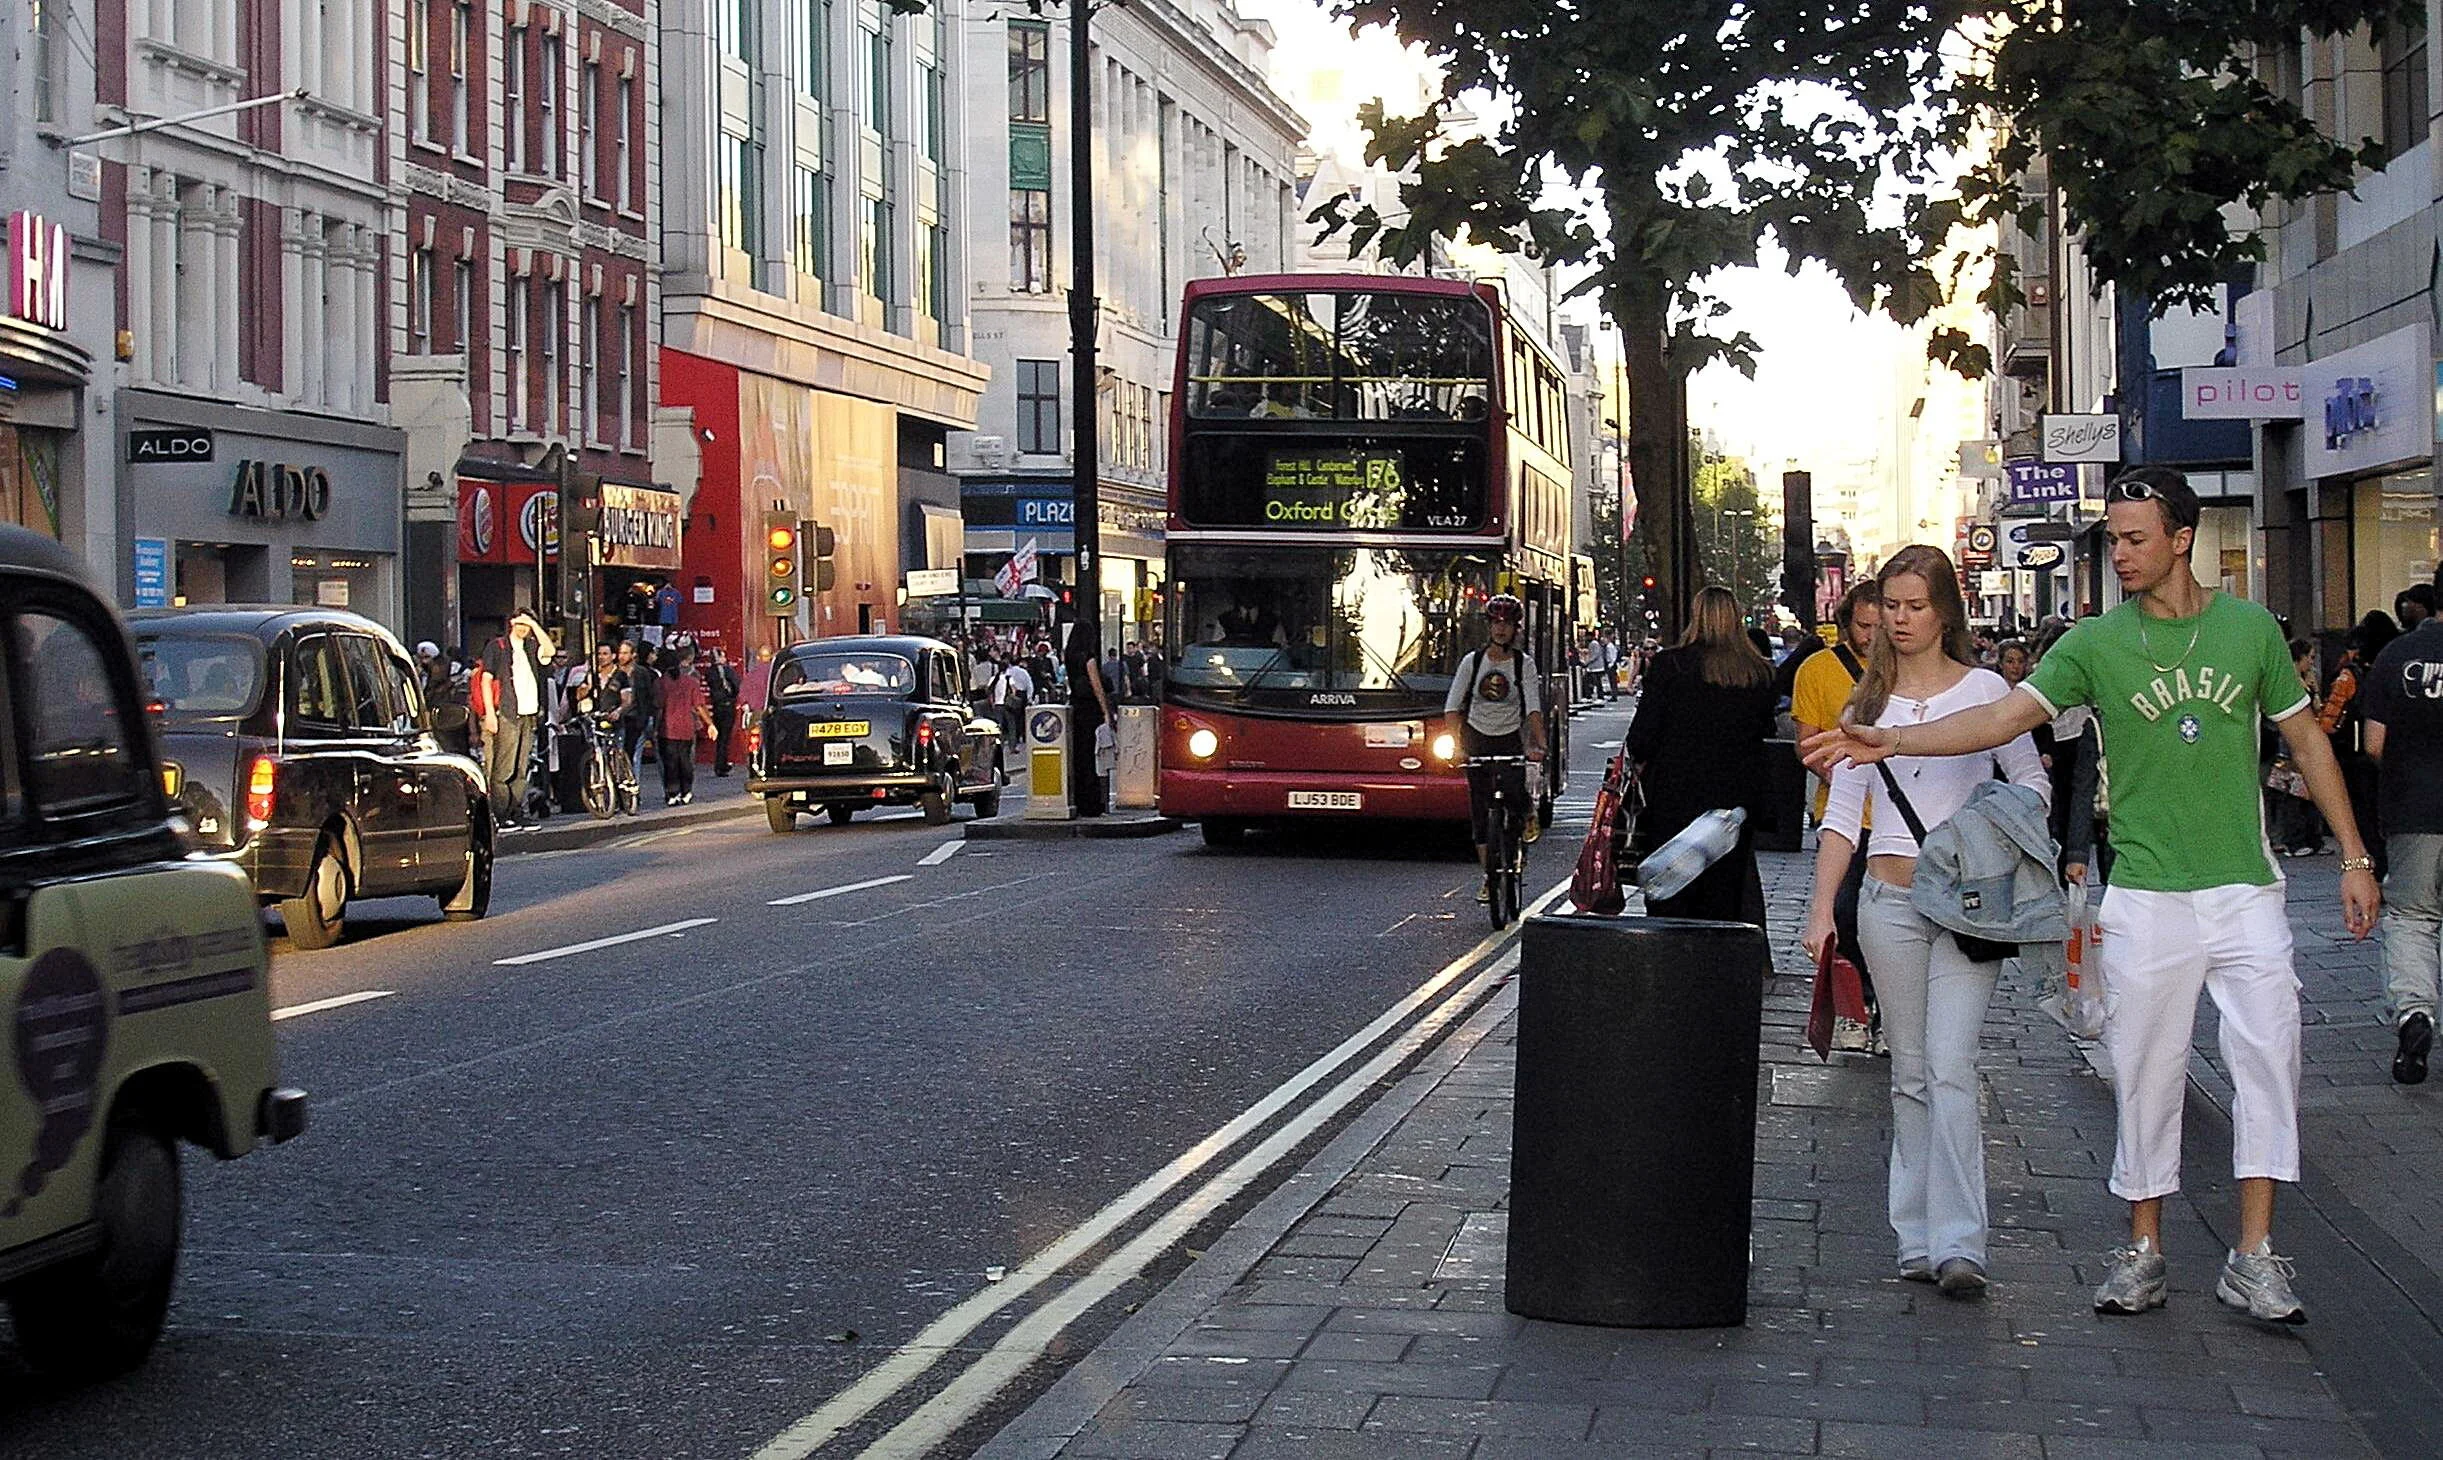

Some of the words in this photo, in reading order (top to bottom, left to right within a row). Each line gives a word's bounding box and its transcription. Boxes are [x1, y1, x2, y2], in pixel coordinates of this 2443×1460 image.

[2197, 379, 2300, 407] pilot
[138, 437, 211, 455] ALDO
[2047, 421, 2117, 456] Shellys
[2014, 466, 2066, 481] The
[228, 459, 332, 522] ALDO
[2016, 482, 2074, 499] Link
[1265, 500, 1334, 520] Oxford
[604, 506, 646, 546] BURGER
[647, 512, 673, 549] KING
[1310, 693, 1357, 705] ARRIVA
[2130, 666, 2243, 722] BRASIL
[811, 723, 842, 734] R478
[844, 722, 867, 733] EGY
[1293, 794, 1328, 806] LJ53
[1330, 794, 1356, 807] BDE
